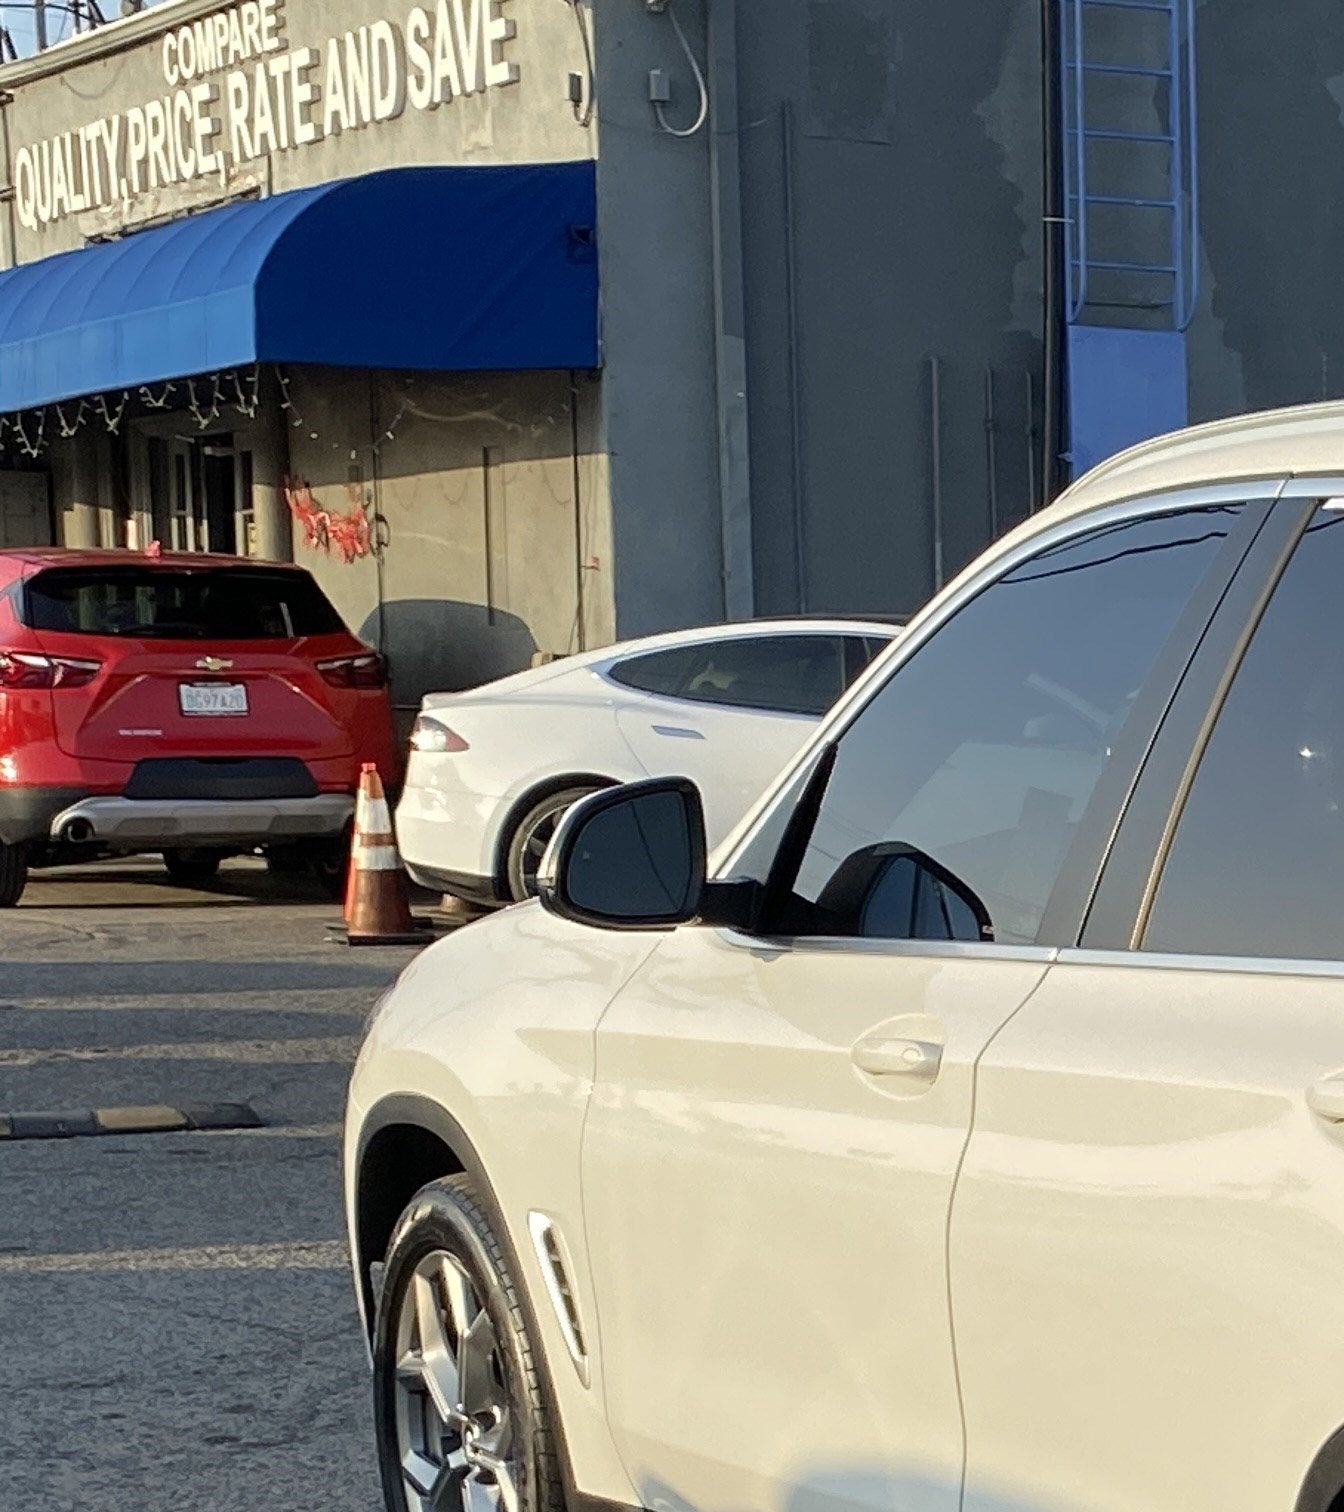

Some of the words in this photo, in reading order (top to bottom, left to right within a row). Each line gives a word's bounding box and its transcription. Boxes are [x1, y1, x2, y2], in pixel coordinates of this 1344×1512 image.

[126, 83, 225, 188] PRICE,
[228, 47, 317, 160] RATE
[323, 19, 400, 136] AND
[406, 0, 513, 110] SAVE
[162, 1, 282, 86] COMPARE
